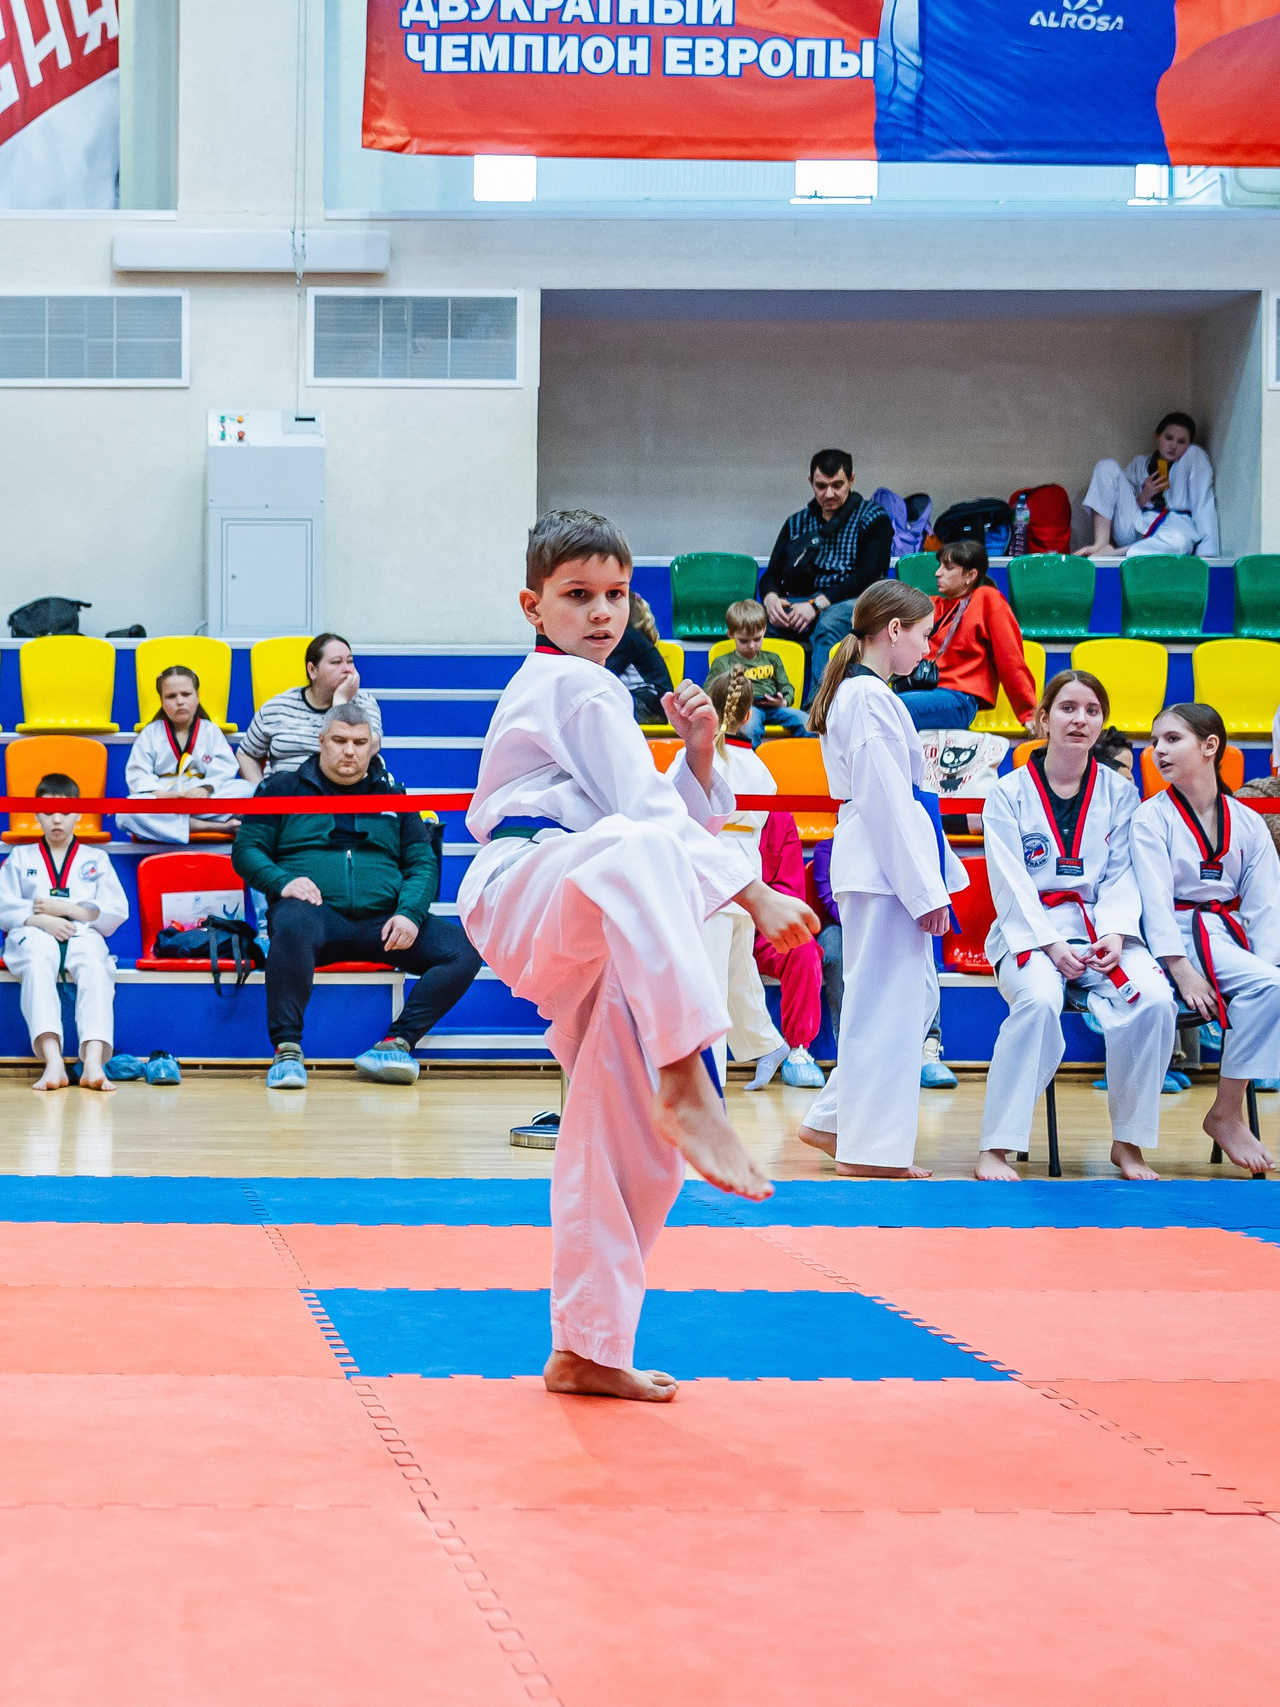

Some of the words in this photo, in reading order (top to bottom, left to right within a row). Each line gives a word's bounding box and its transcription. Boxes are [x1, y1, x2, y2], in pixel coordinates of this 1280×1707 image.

[1029, 10, 1125, 32] ALROSA
[406, 34, 649, 74] ЧЕМПИОН
[664, 36, 875, 79] ЕВРОПЫ
